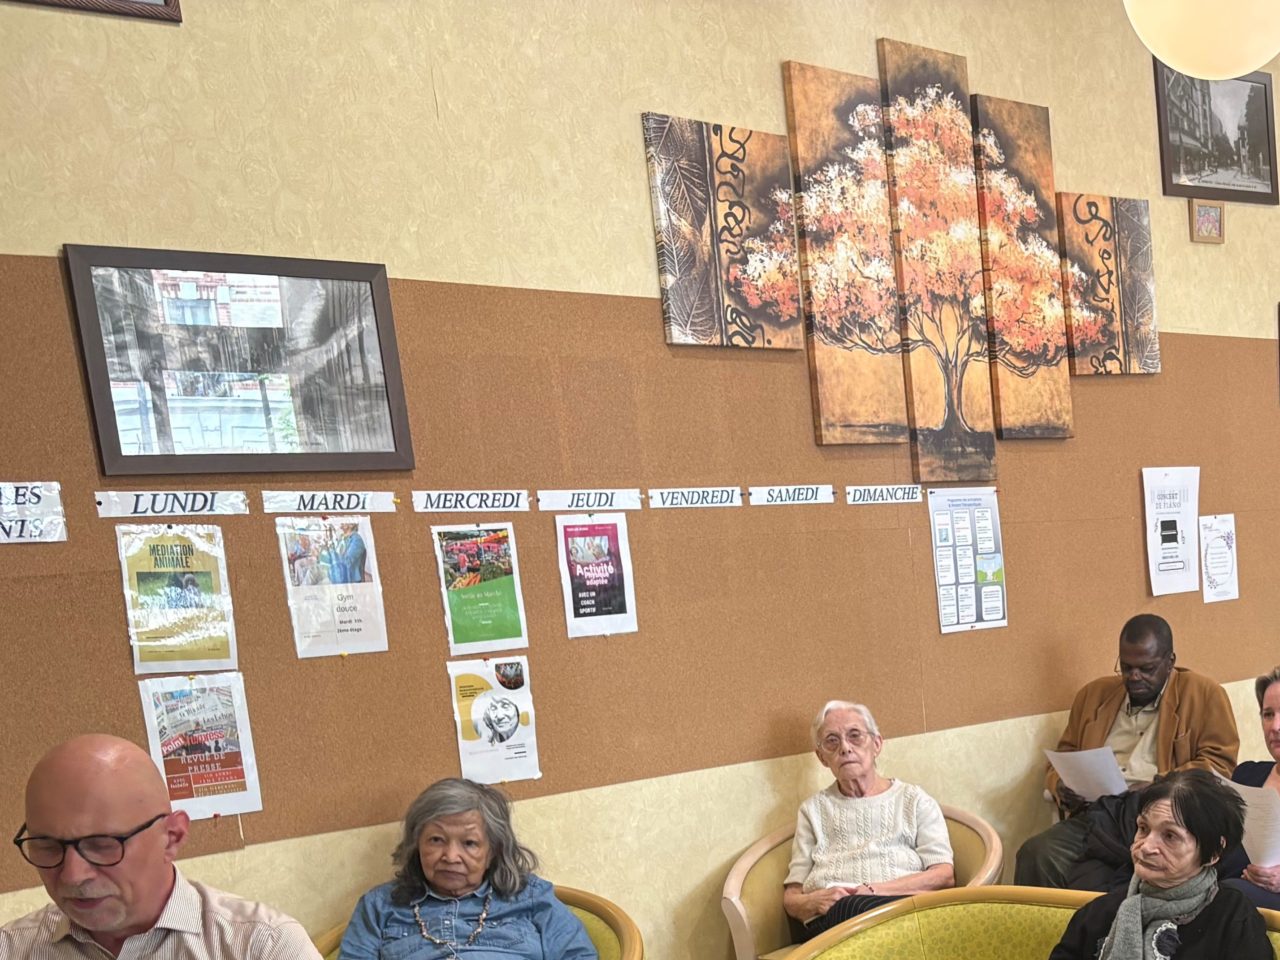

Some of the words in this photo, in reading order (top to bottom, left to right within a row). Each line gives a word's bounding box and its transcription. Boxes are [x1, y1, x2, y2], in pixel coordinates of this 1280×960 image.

[296, 493, 367, 511] MARDI
[424, 492, 522, 509] MERCREDI
[567, 492, 616, 508] JEUDI
[660, 489, 735, 506] VENDREDI
[766, 487, 819, 503] SAMEDI
[852, 486, 919, 502] DIMANCHE
[131, 492, 218, 514] LUNDI
[149, 544, 194, 557] MEDIATION
[154, 556, 190, 569] ANIMALE
[576, 562, 614, 576] Activité
[336, 594, 354, 603] Gym
[181, 753, 211, 764] REVUE
[214, 752, 226, 760] DE
[188, 763, 222, 774] PRESSE
